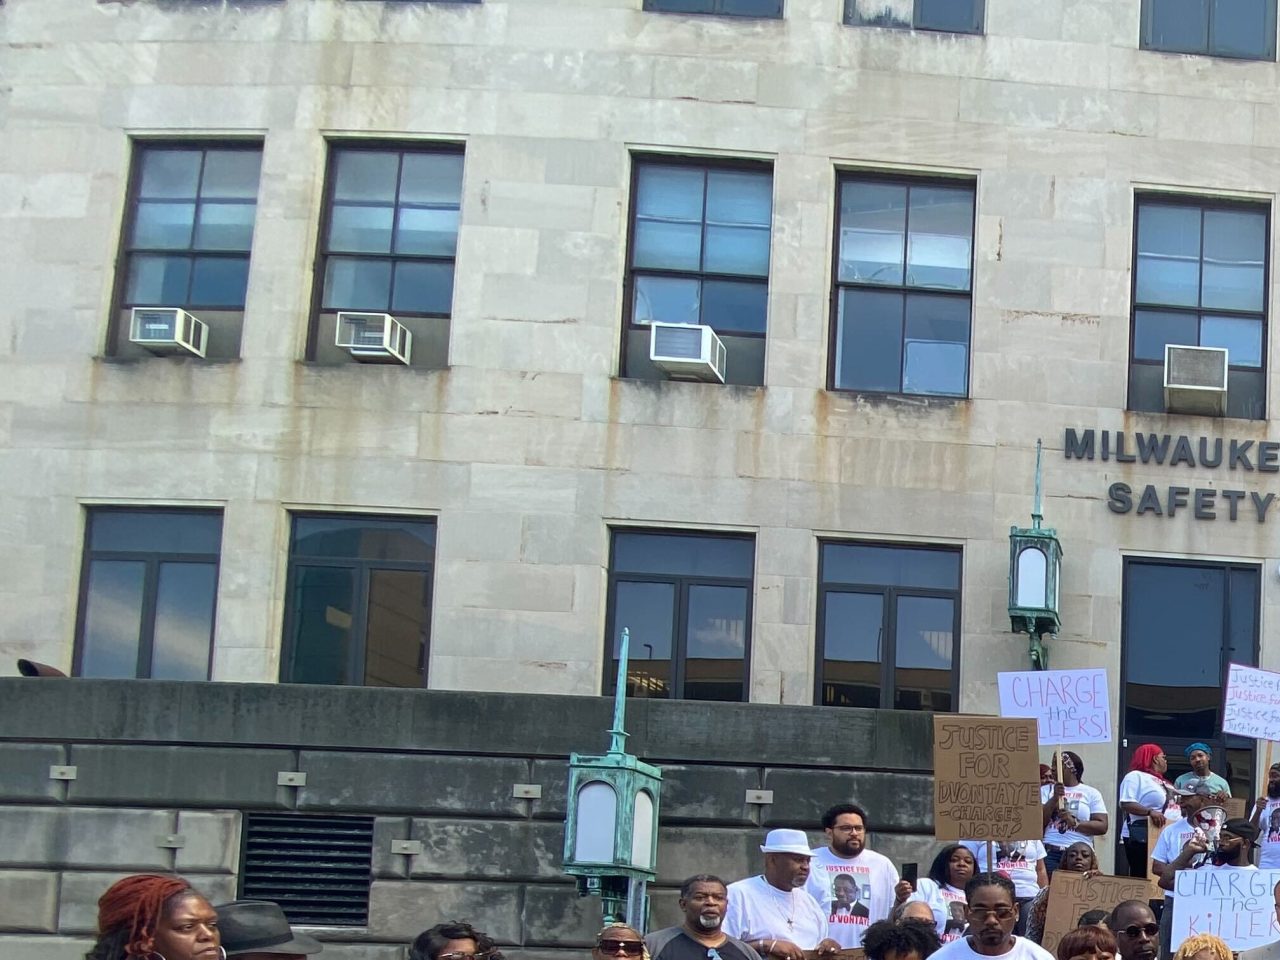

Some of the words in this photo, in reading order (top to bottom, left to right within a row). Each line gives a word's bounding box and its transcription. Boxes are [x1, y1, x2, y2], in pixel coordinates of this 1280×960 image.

[1107, 482, 1275, 522] SAFETY
[1012, 674, 1105, 709] CHARGE
[1037, 711, 1108, 739] LLERS!
[1044, 706, 1077, 721] the
[939, 724, 1029, 751] JUSTICE
[959, 752, 1010, 778] FOR
[938, 780, 1040, 806] DVONTAYE
[959, 822, 1022, 838] NOW!
[826, 865, 854, 873] JUSTICE
[1056, 877, 1145, 902] JUSTICE
[1214, 897, 1264, 912] The
